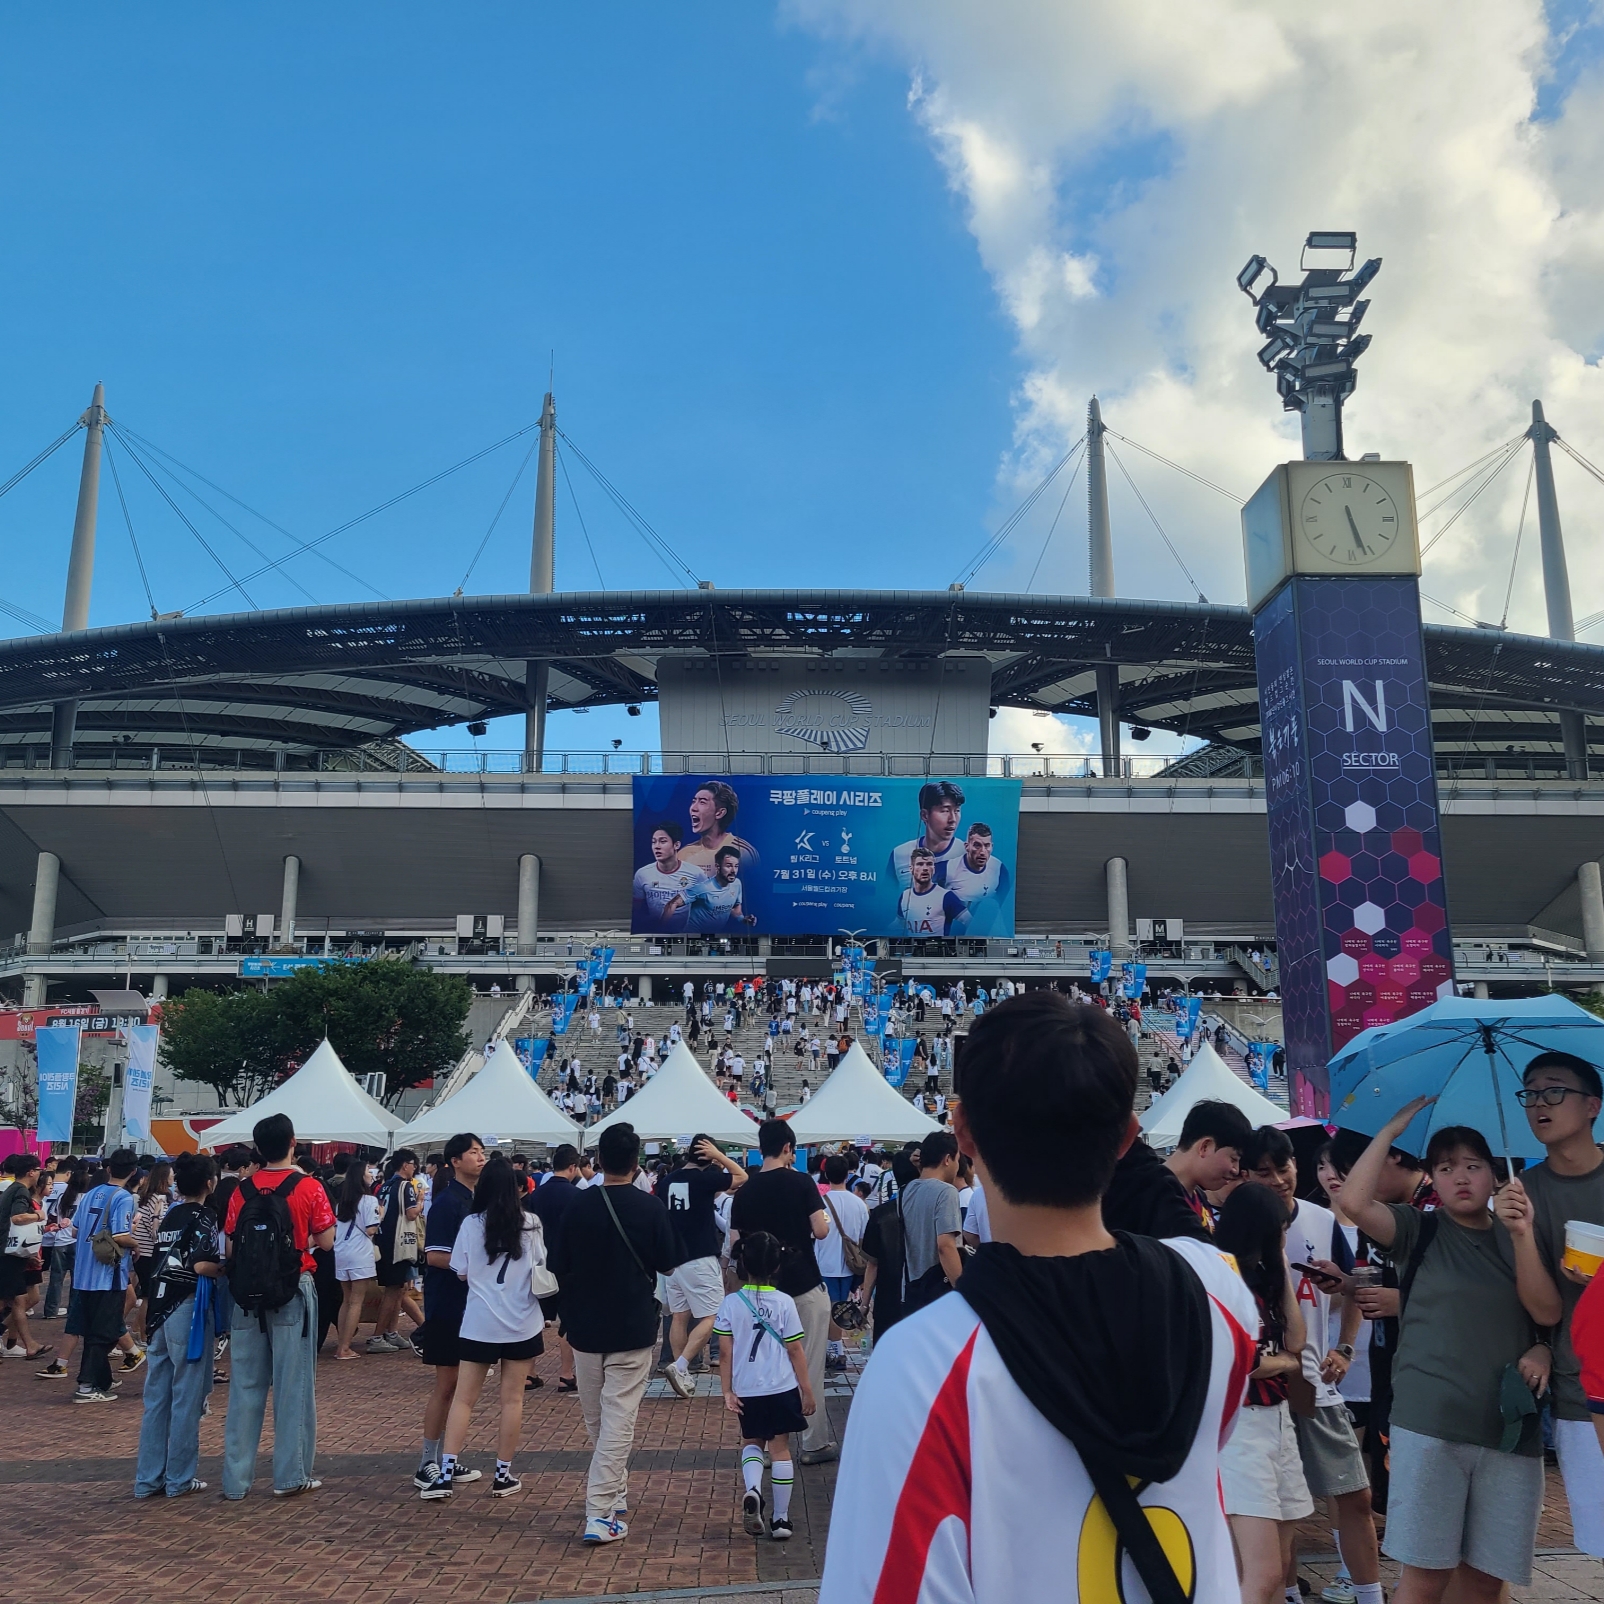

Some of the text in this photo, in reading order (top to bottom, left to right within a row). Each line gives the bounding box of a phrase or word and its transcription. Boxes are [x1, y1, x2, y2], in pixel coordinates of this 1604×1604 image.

[1342, 680, 1387, 732] N
[718, 714, 931, 728] SEOUL WORLD CUP STADIUM
[1342, 753, 1399, 766] SECTOR
[769, 789, 882, 807] 쿠팡플레이 시리즈
[800, 854, 820, 863] K리그
[835, 856, 857, 864] 토트넘
[773, 869, 876, 882] 7월 31일 (수) 오후 8시
[801, 884, 848, 893] 서울월드컵경기장
[246, 919, 253, 928] H
[1155, 924, 1164, 932] M
[70, 1018, 89, 1029] 16일
[92, 1018, 108, 1030] (금)
[870, 1175, 879, 1191] 7
[87, 1207, 103, 1242] 7
[752, 1308, 772, 1318] SON
[749, 1322, 770, 1362] 7
